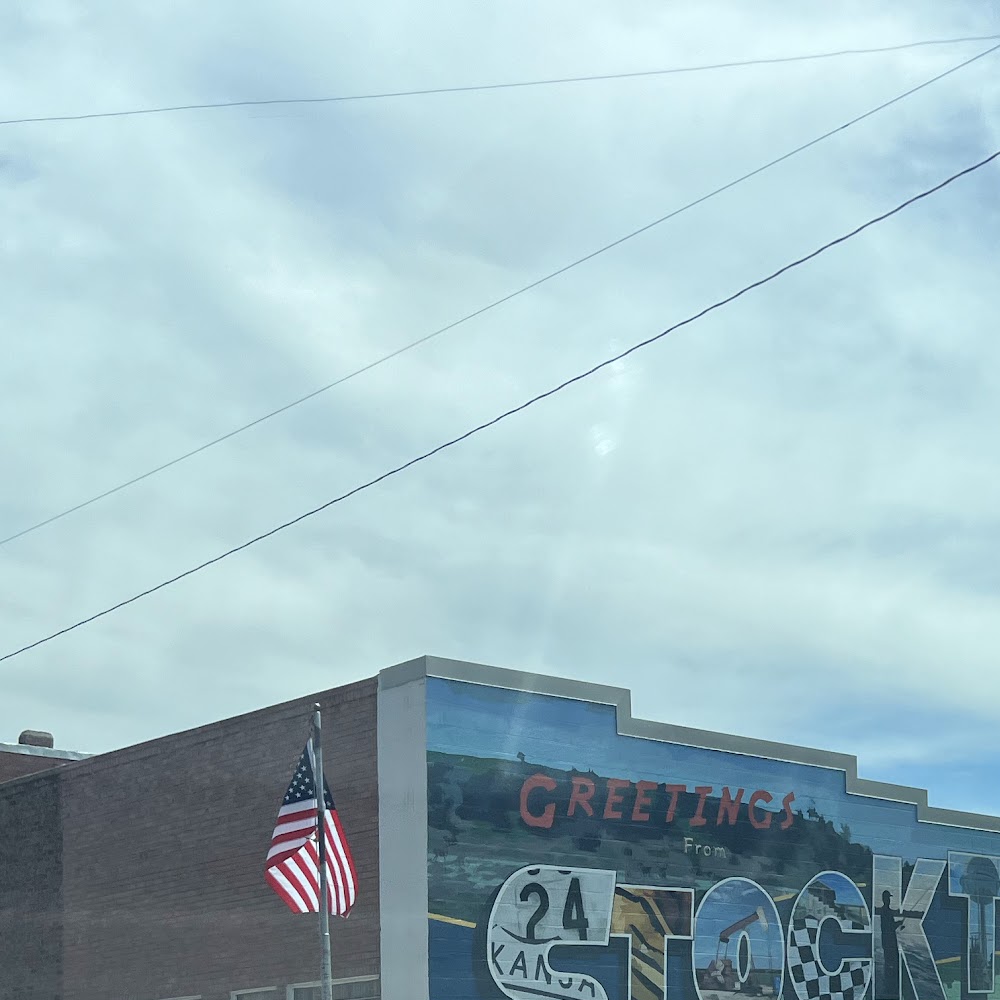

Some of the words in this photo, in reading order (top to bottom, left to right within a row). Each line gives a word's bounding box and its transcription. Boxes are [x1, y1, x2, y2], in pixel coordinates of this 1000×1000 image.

[519, 773, 796, 830] GREETINGS
[683, 837, 727, 859] From
[519, 877, 589, 941] 24
